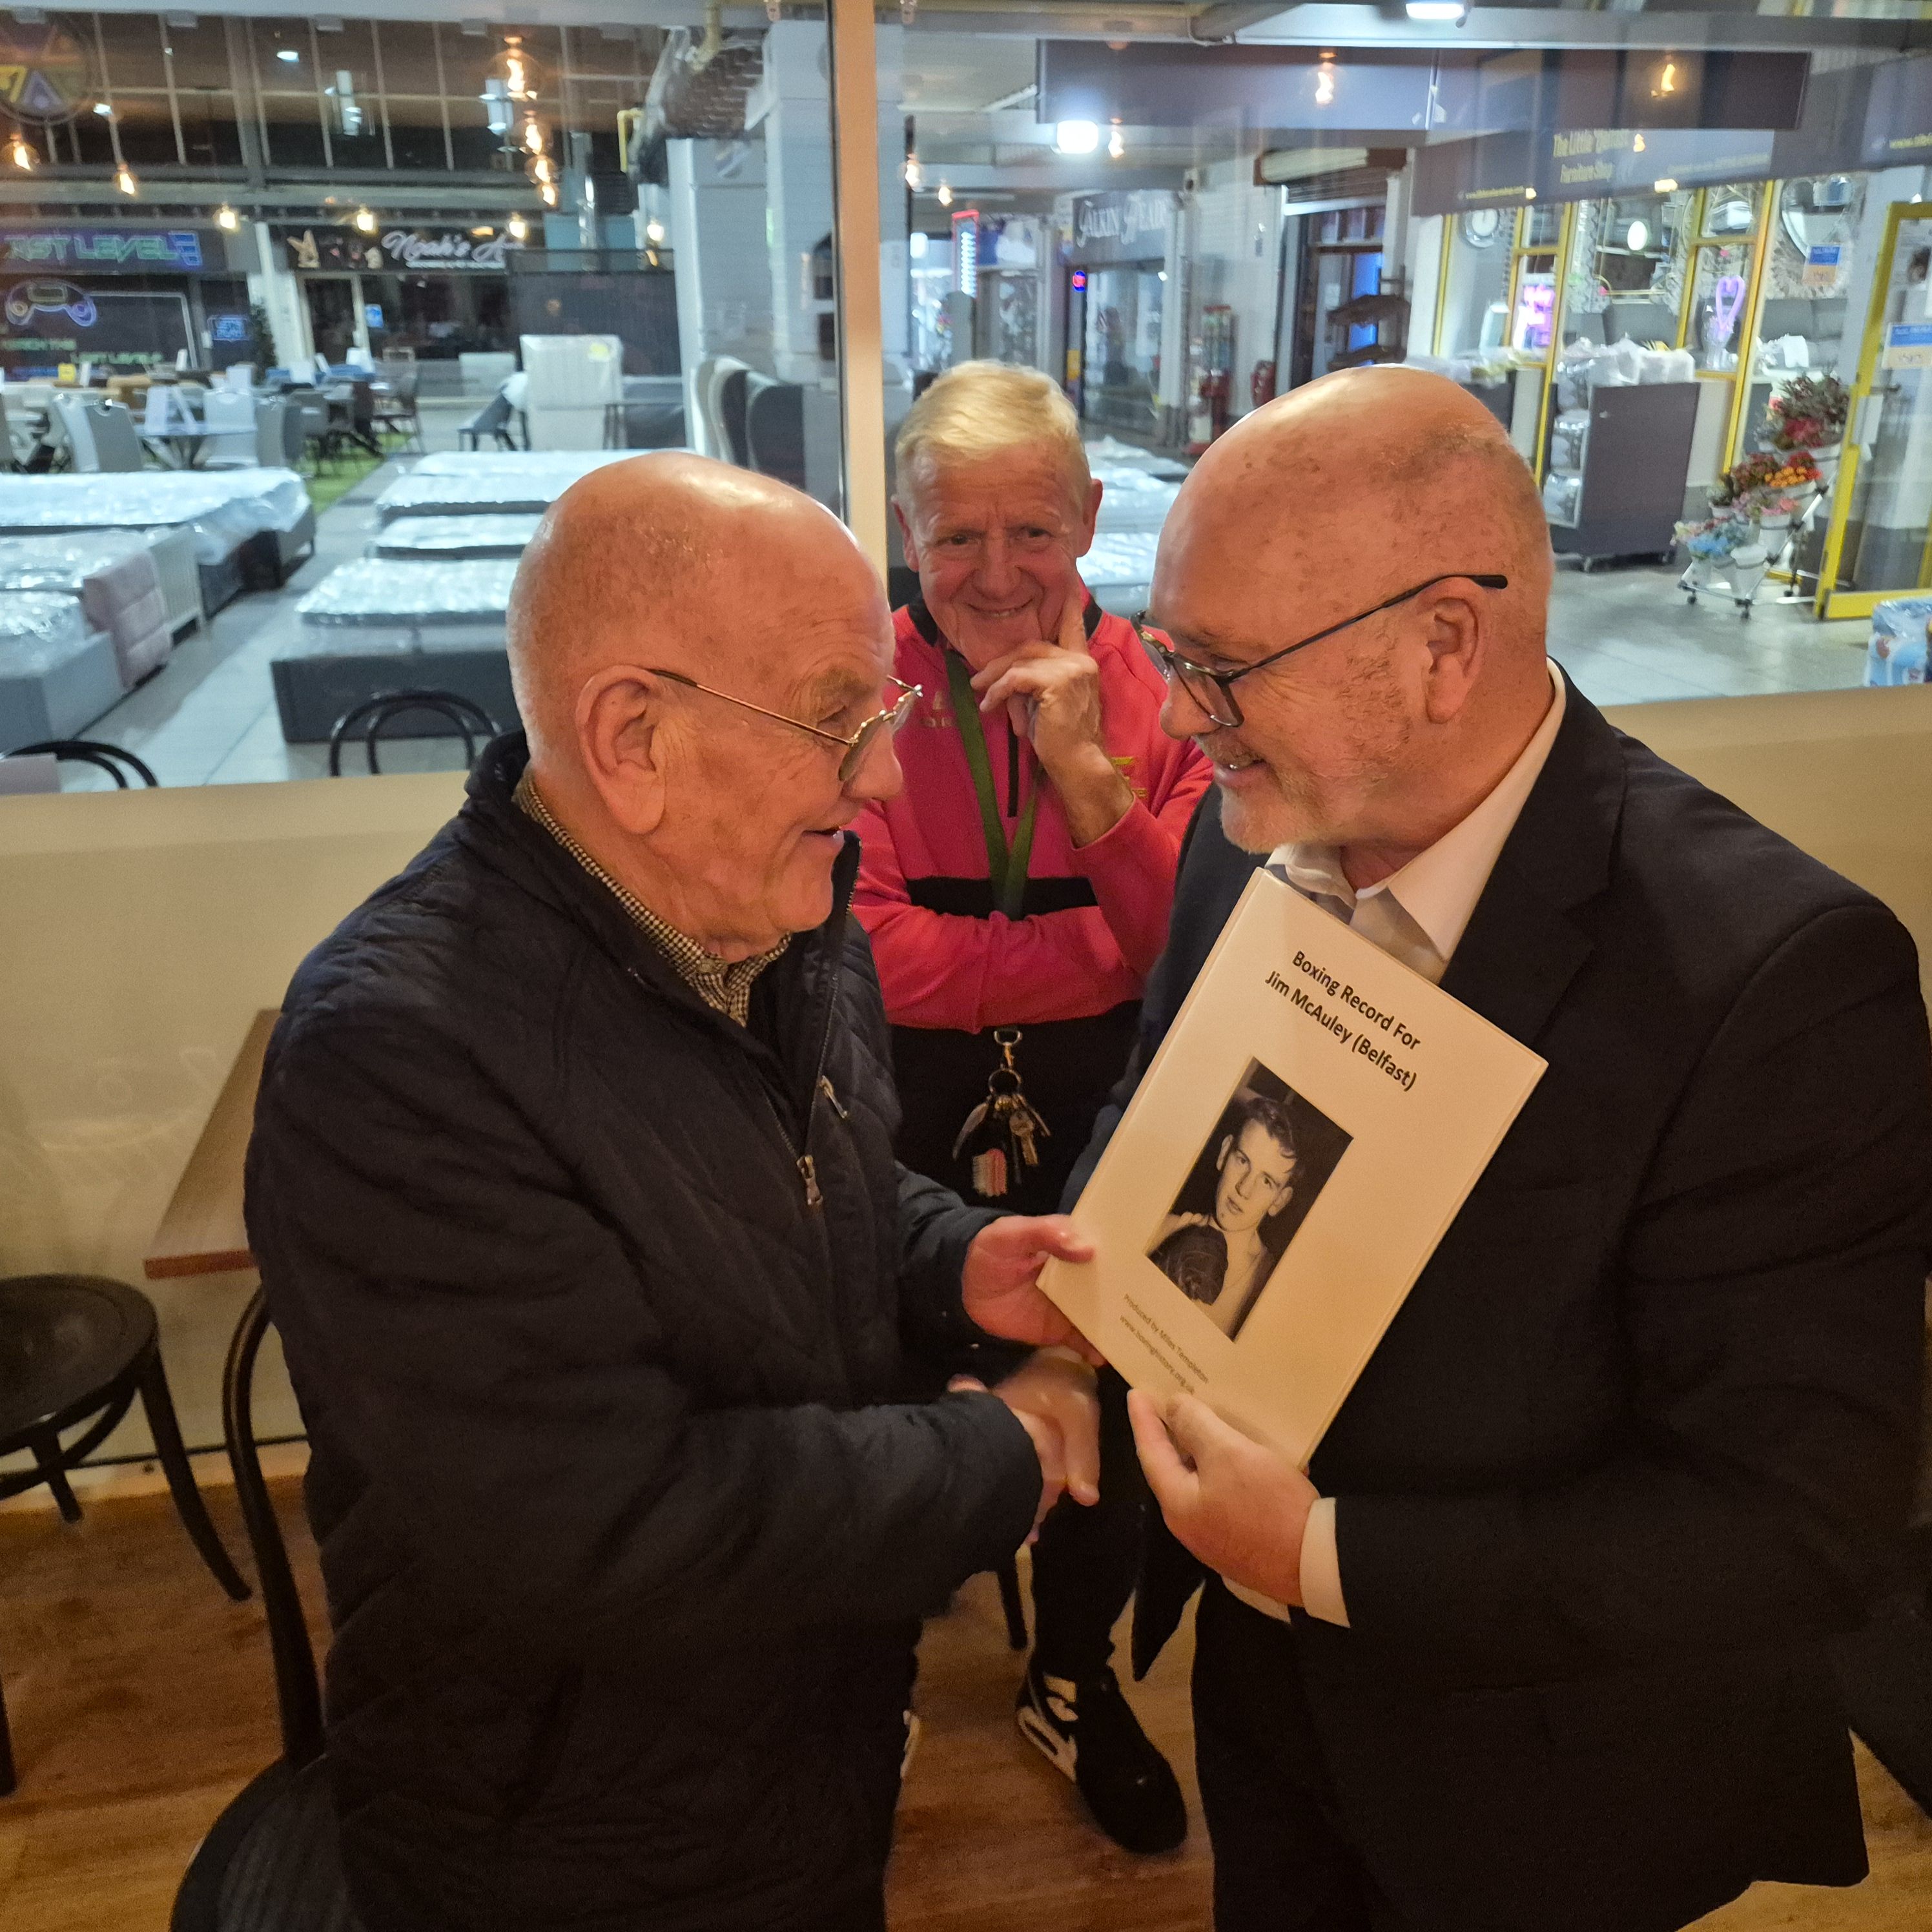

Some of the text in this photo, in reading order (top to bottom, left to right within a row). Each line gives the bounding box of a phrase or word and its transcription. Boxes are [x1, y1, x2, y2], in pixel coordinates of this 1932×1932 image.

[1264, 971, 1417, 1092] Jim McAuley (Belfast)
[1292, 951, 1421, 1050] Boxing Record For
[1124, 1293, 1209, 1384] Produced by Miles Templeton
